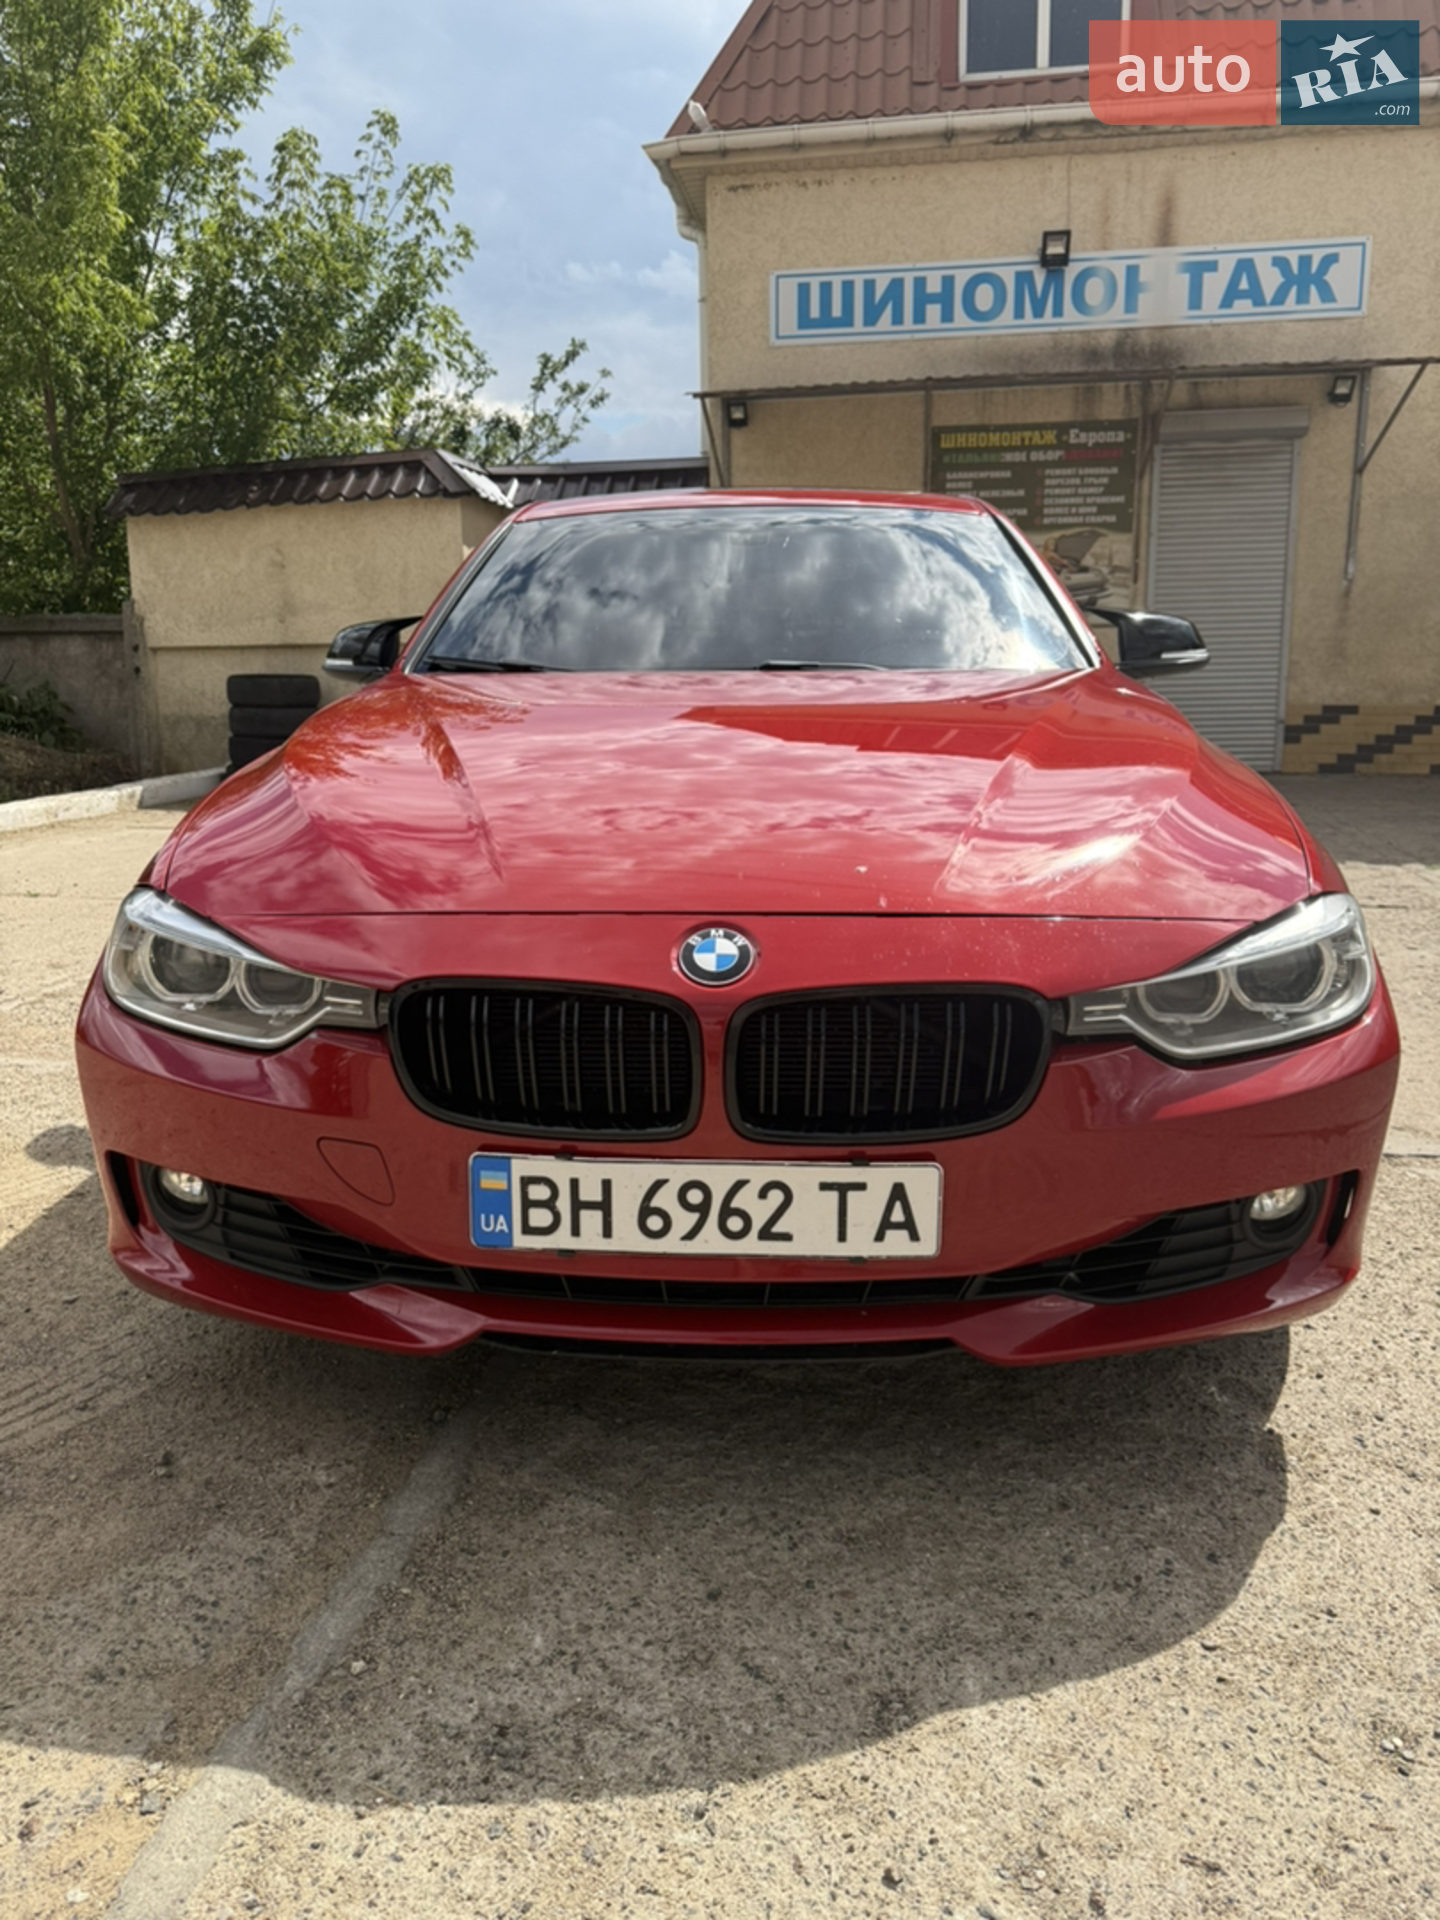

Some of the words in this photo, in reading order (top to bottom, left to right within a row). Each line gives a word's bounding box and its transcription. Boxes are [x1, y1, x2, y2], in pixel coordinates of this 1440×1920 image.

[940, 430, 1058, 448] ШИНОМОНТАЖ
[688, 928, 747, 946] BMW
[519, 1175, 613, 1240] BH
[636, 1178, 795, 1242] 6962
[818, 1181, 922, 1243] TA
[480, 1213, 509, 1234] UA
